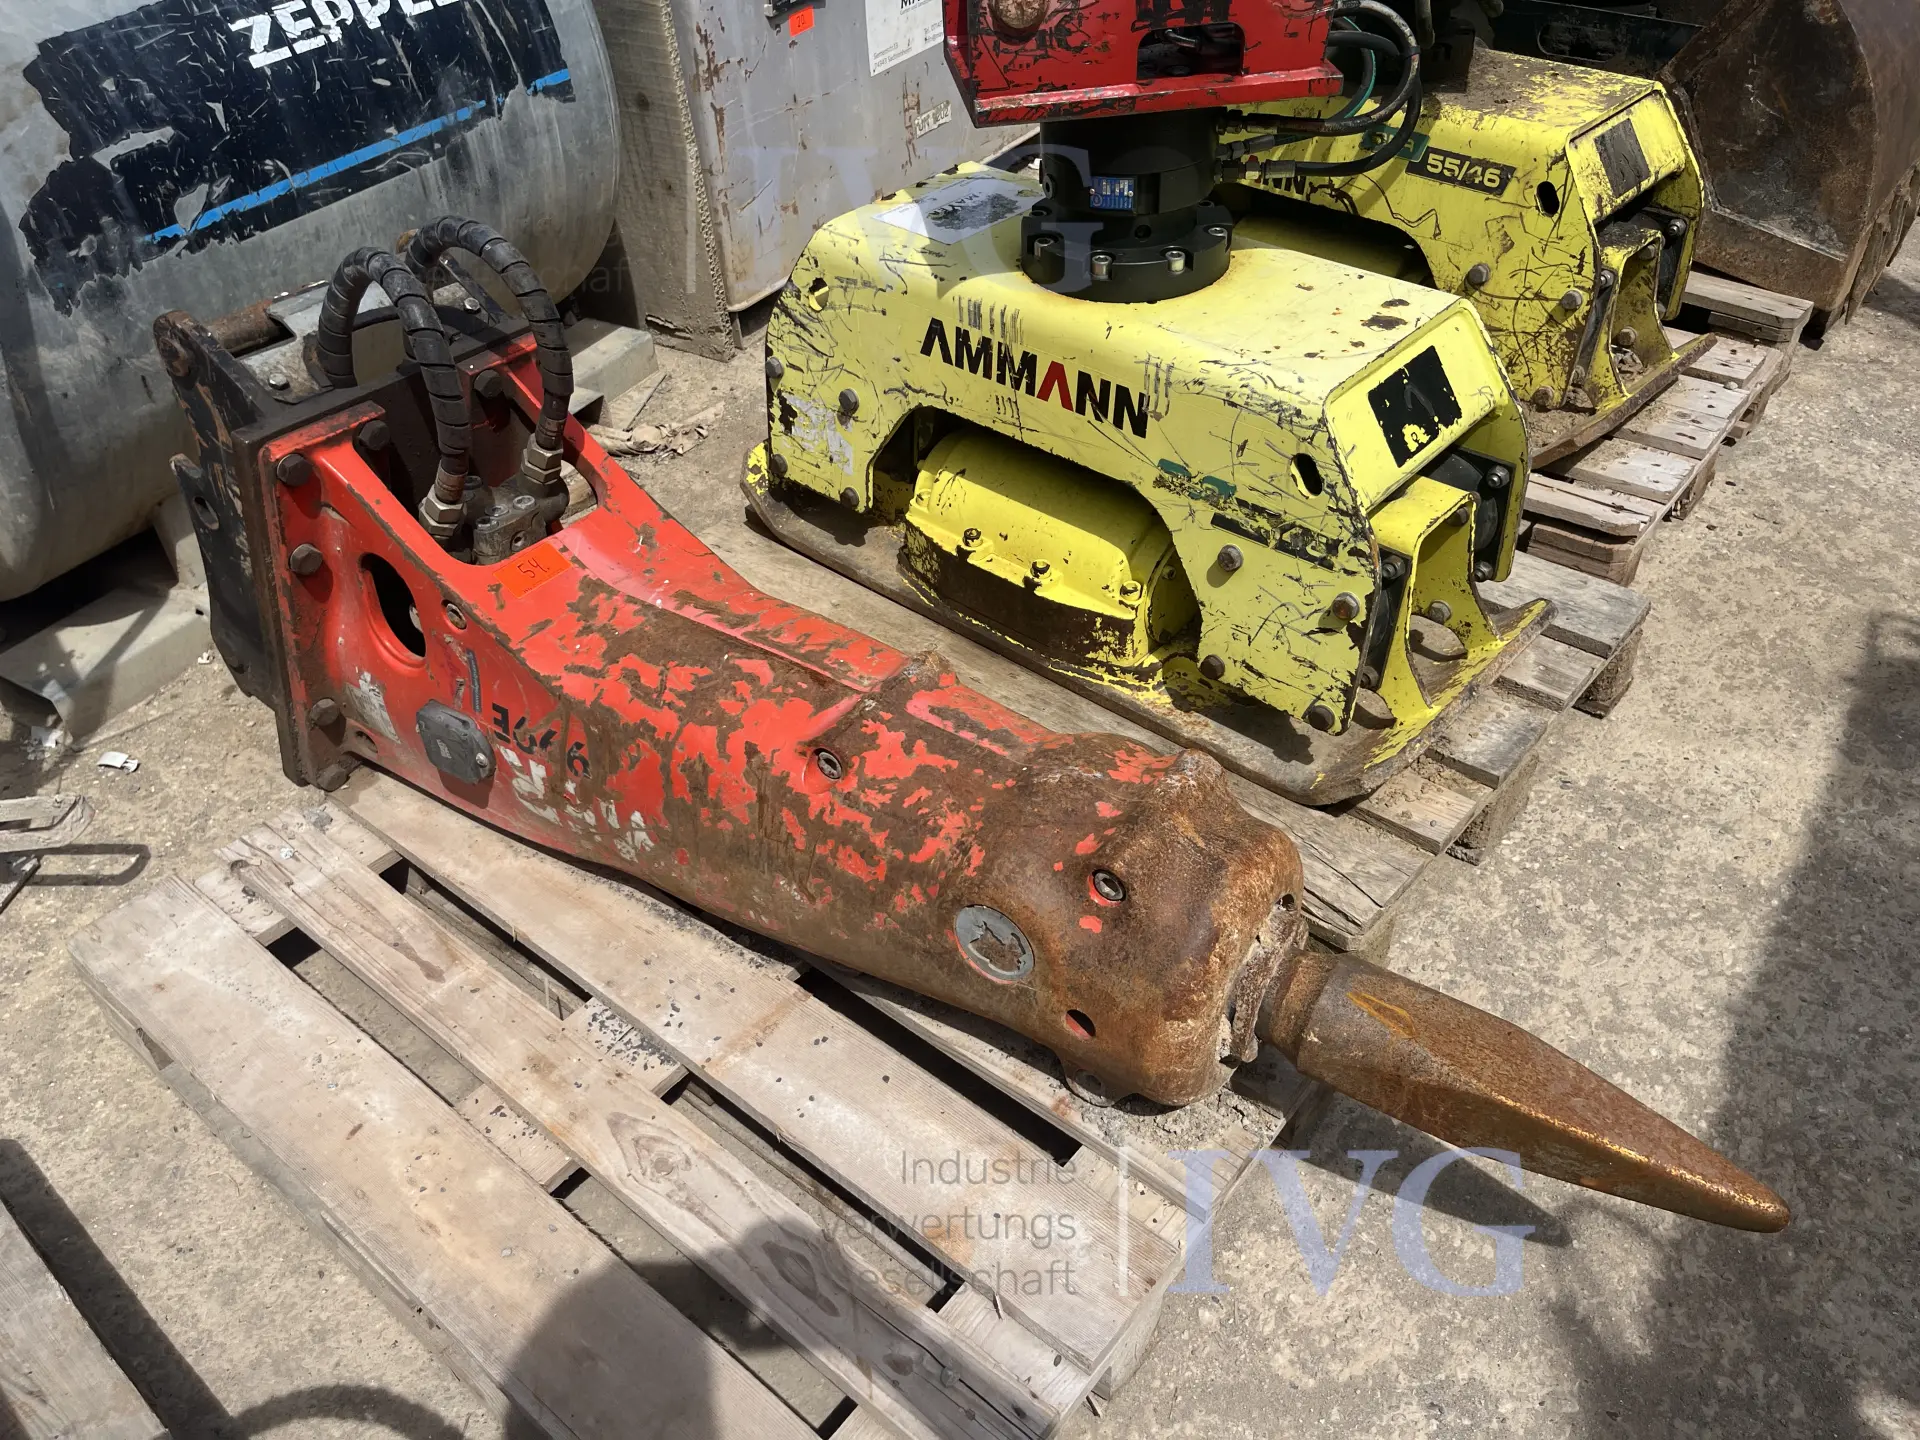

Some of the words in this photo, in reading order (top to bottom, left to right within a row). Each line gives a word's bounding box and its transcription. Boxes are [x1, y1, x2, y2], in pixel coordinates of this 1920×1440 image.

[228, 0, 461, 69] ZEPP
[1426, 152, 1501, 188] 55/46
[920, 317, 1151, 439] AMMANN
